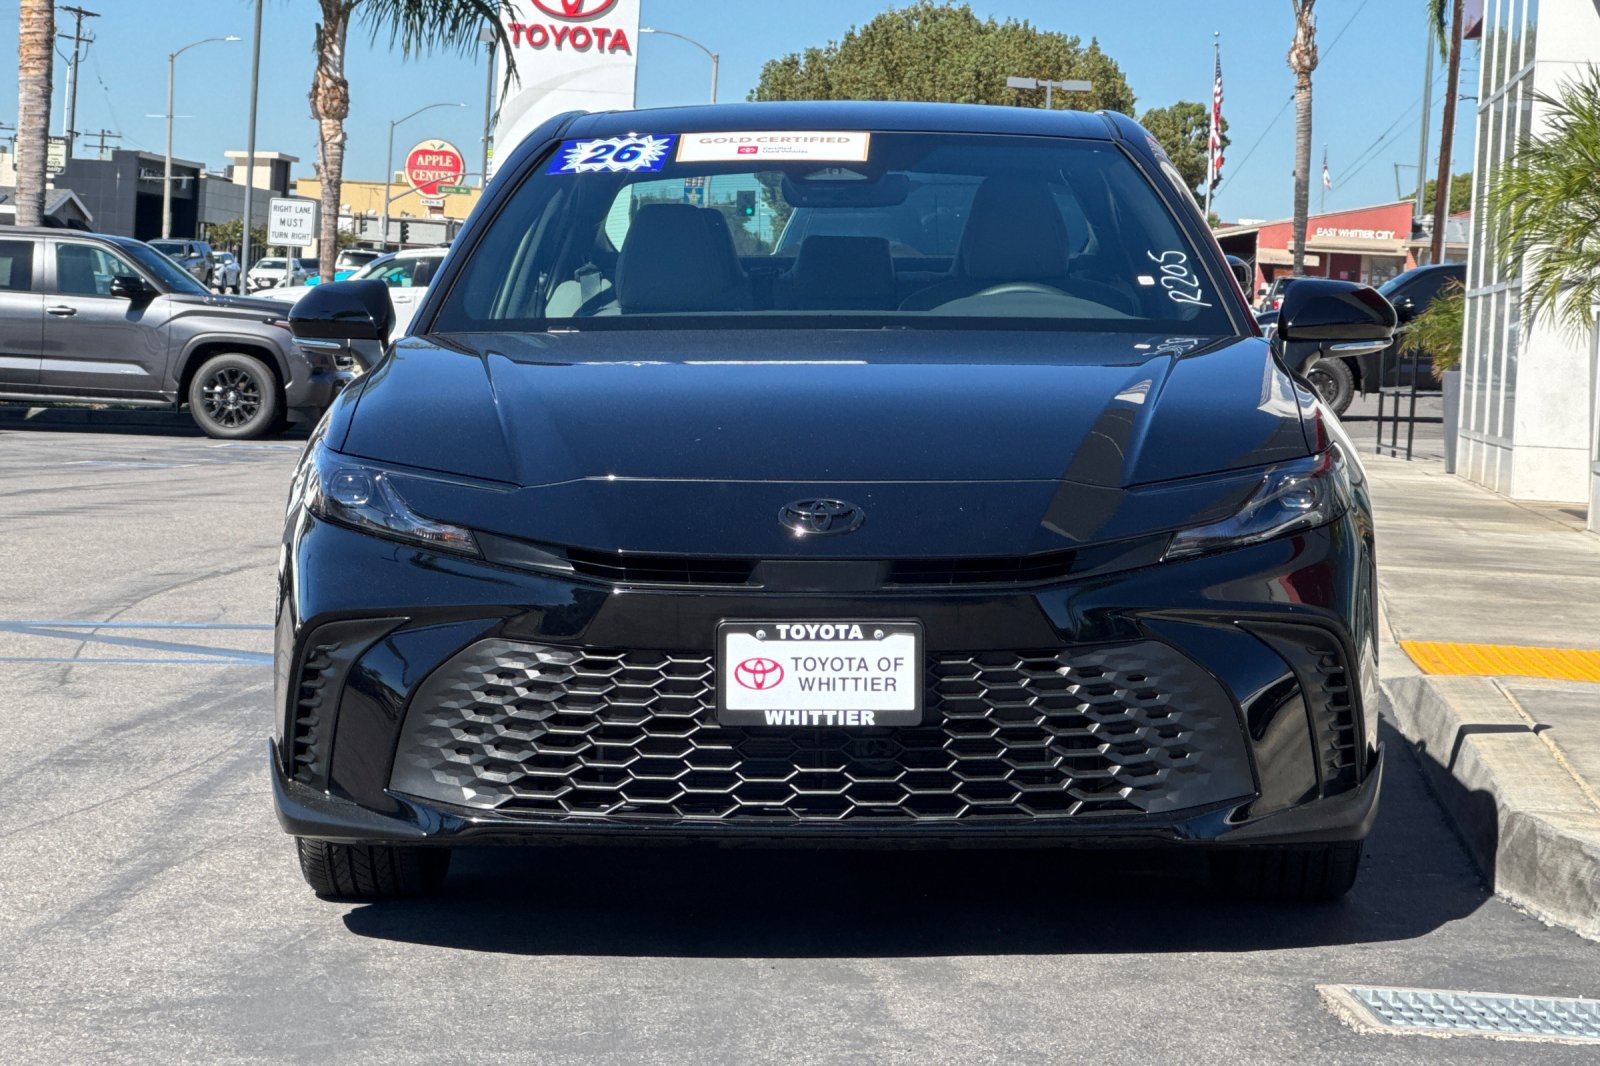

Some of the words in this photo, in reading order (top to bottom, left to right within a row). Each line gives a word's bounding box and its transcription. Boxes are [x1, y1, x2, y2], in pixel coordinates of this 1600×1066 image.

[507, 23, 630, 54] TOYOTA
[699, 136, 752, 144] GOLD
[756, 136, 851, 144] CERTIFIED
[580, 143, 647, 164] 26
[416, 154, 454, 167] APPLE
[411, 170, 455, 183] CENTER
[273, 204, 292, 213] RIGHT
[295, 206, 311, 214] LANE
[280, 217, 304, 227] MUST
[271, 231, 288, 239] TURN
[291, 232, 310, 241] RIGHT
[1316, 227, 1337, 237] EAST
[1338, 228, 1375, 239] WHITTIER
[1375, 230, 1396, 240] CITY
[776, 624, 863, 640] TOYOTA
[790, 656, 869, 672] TOYOTA
[877, 656, 904, 672] OF
[798, 676, 898, 692] WHITTIER
[764, 710, 876, 726] WHITTIER
